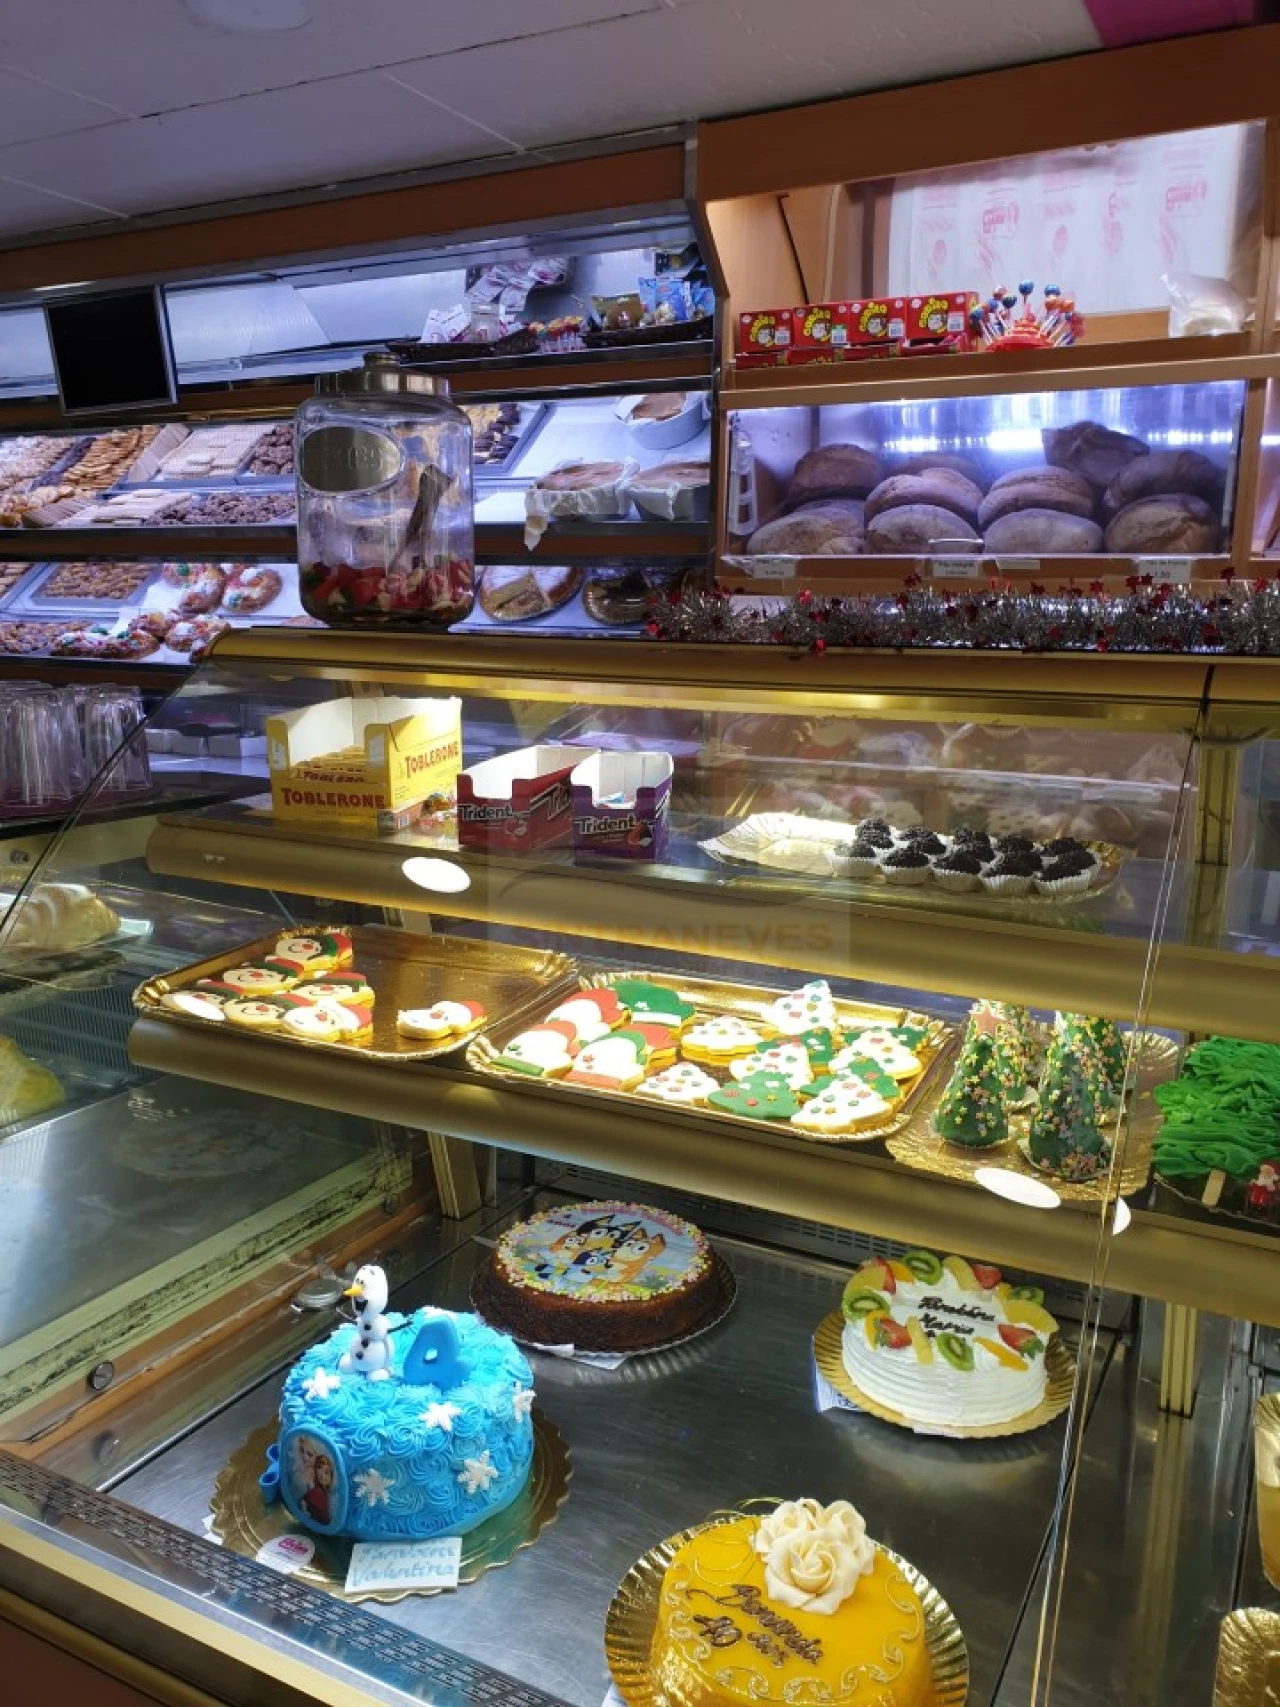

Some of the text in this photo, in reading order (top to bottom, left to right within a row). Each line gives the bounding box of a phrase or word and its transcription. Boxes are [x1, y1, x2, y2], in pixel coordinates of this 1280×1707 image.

[404, 741, 459, 779] TOBLERONE
[281, 787, 385, 809] TOBLERONE
[458, 803, 513, 821] Trident
[574, 813, 637, 834] Trident
